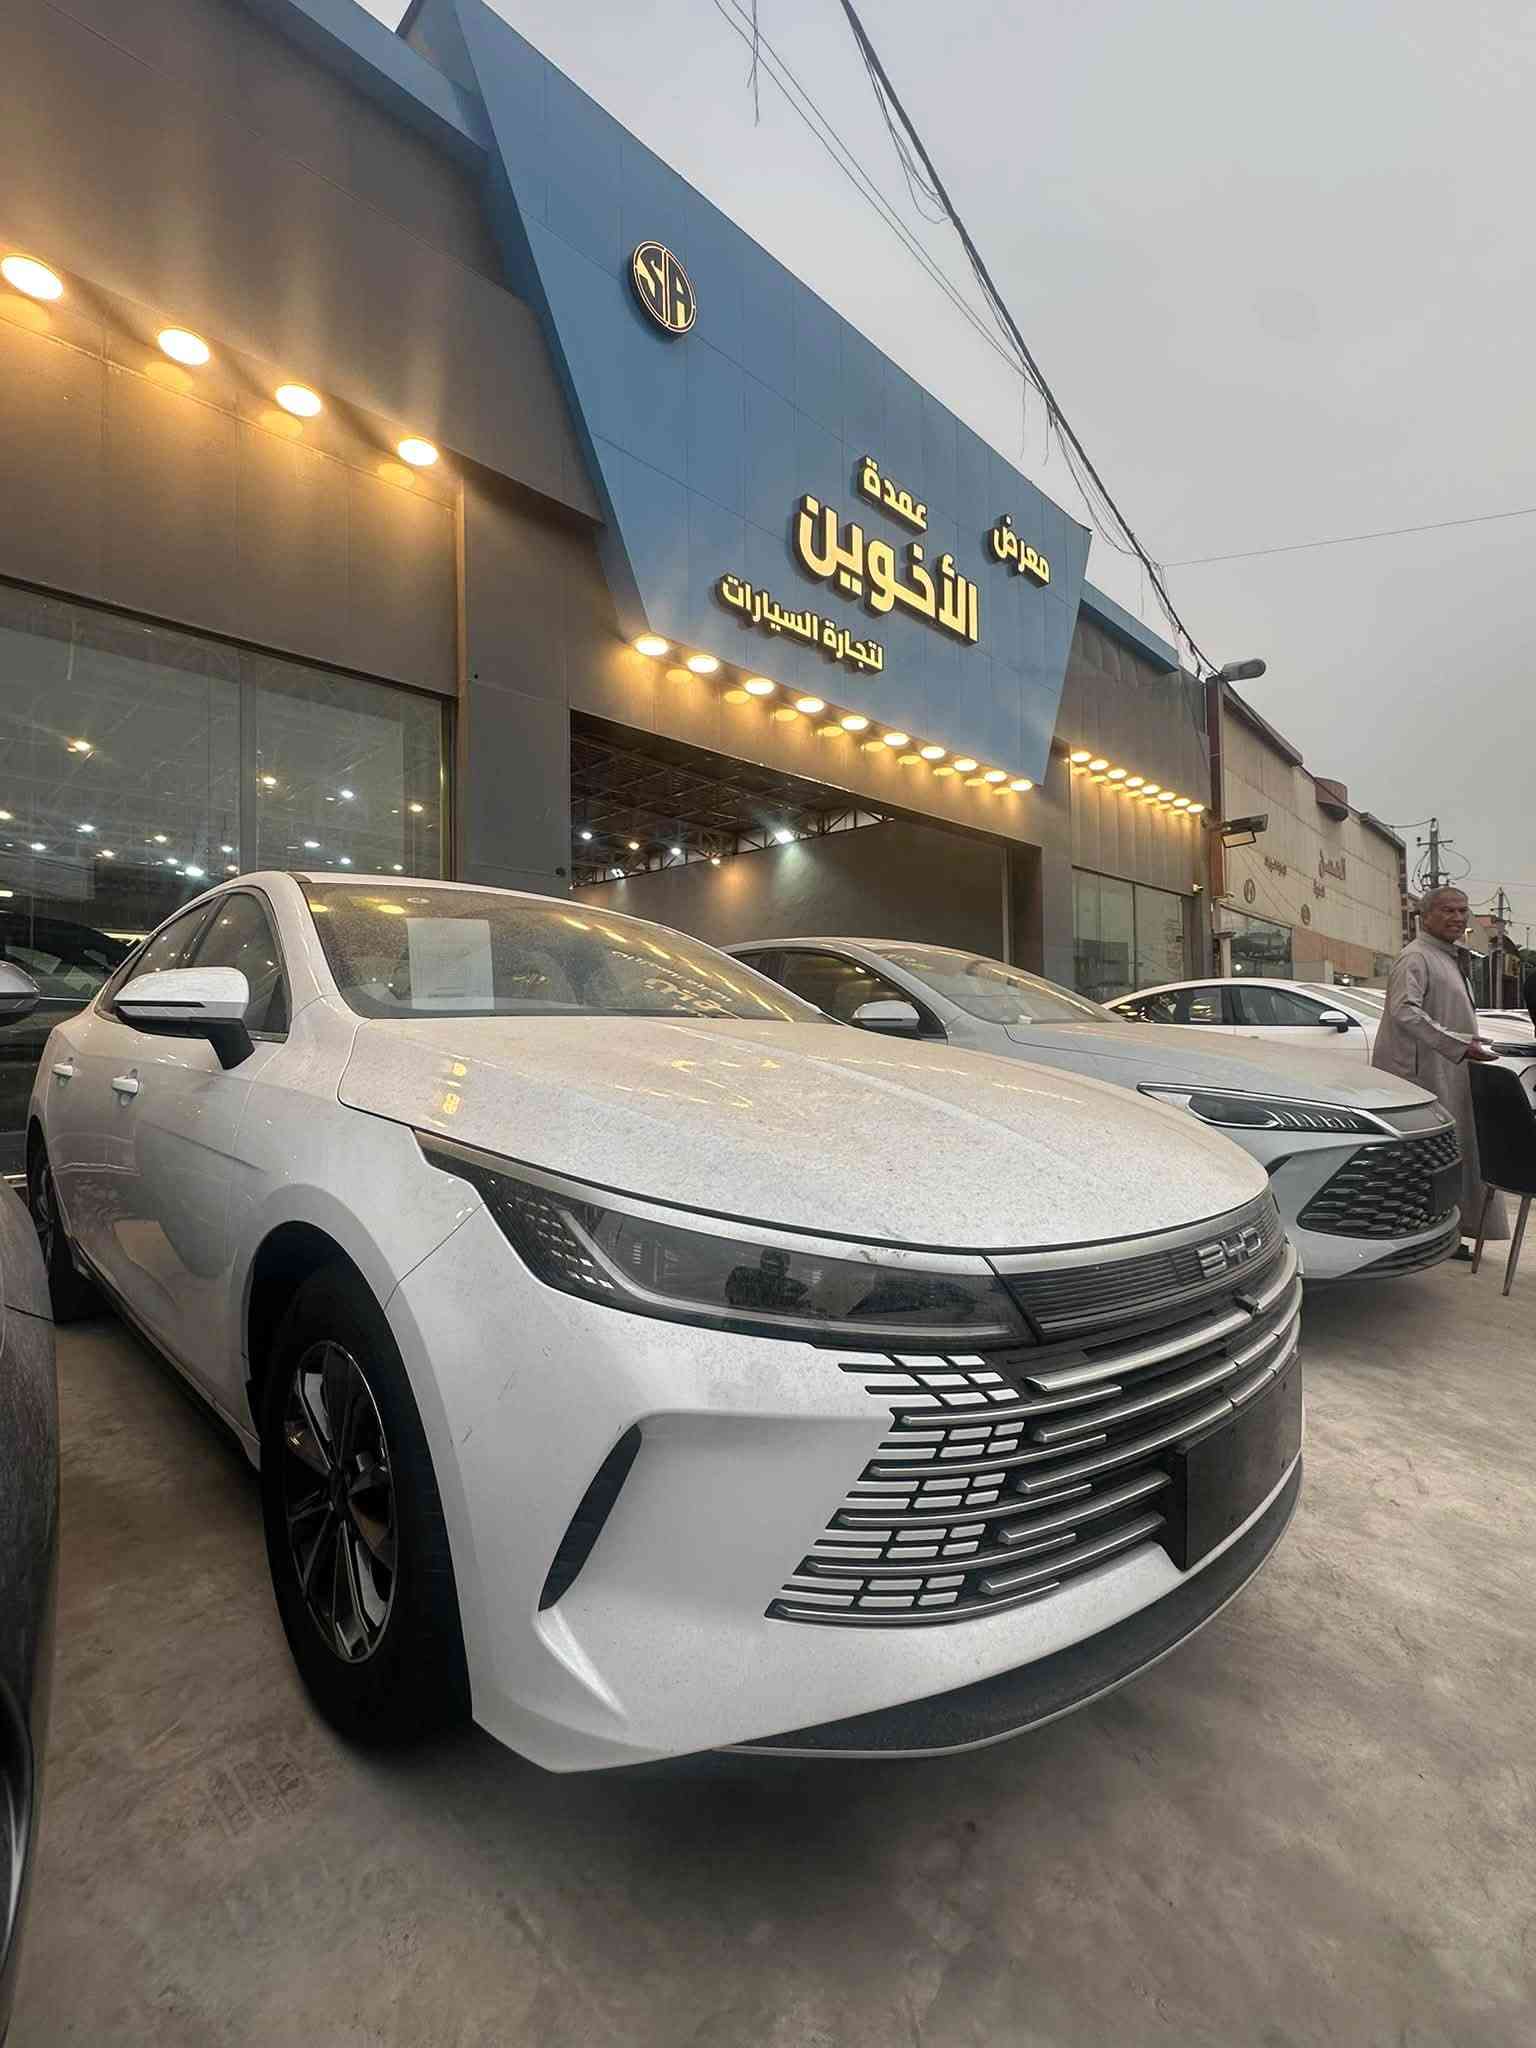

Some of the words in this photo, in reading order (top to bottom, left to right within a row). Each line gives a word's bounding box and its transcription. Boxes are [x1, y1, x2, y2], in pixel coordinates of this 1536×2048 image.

[862, 456, 928, 530] عمدة
[798, 495, 979, 641] الأخوين
[993, 514, 1051, 585] معرض
[720, 575, 819, 641] السيارات
[822, 620, 883, 671] لتجارة
[1197, 1227, 1262, 1279] BYD
